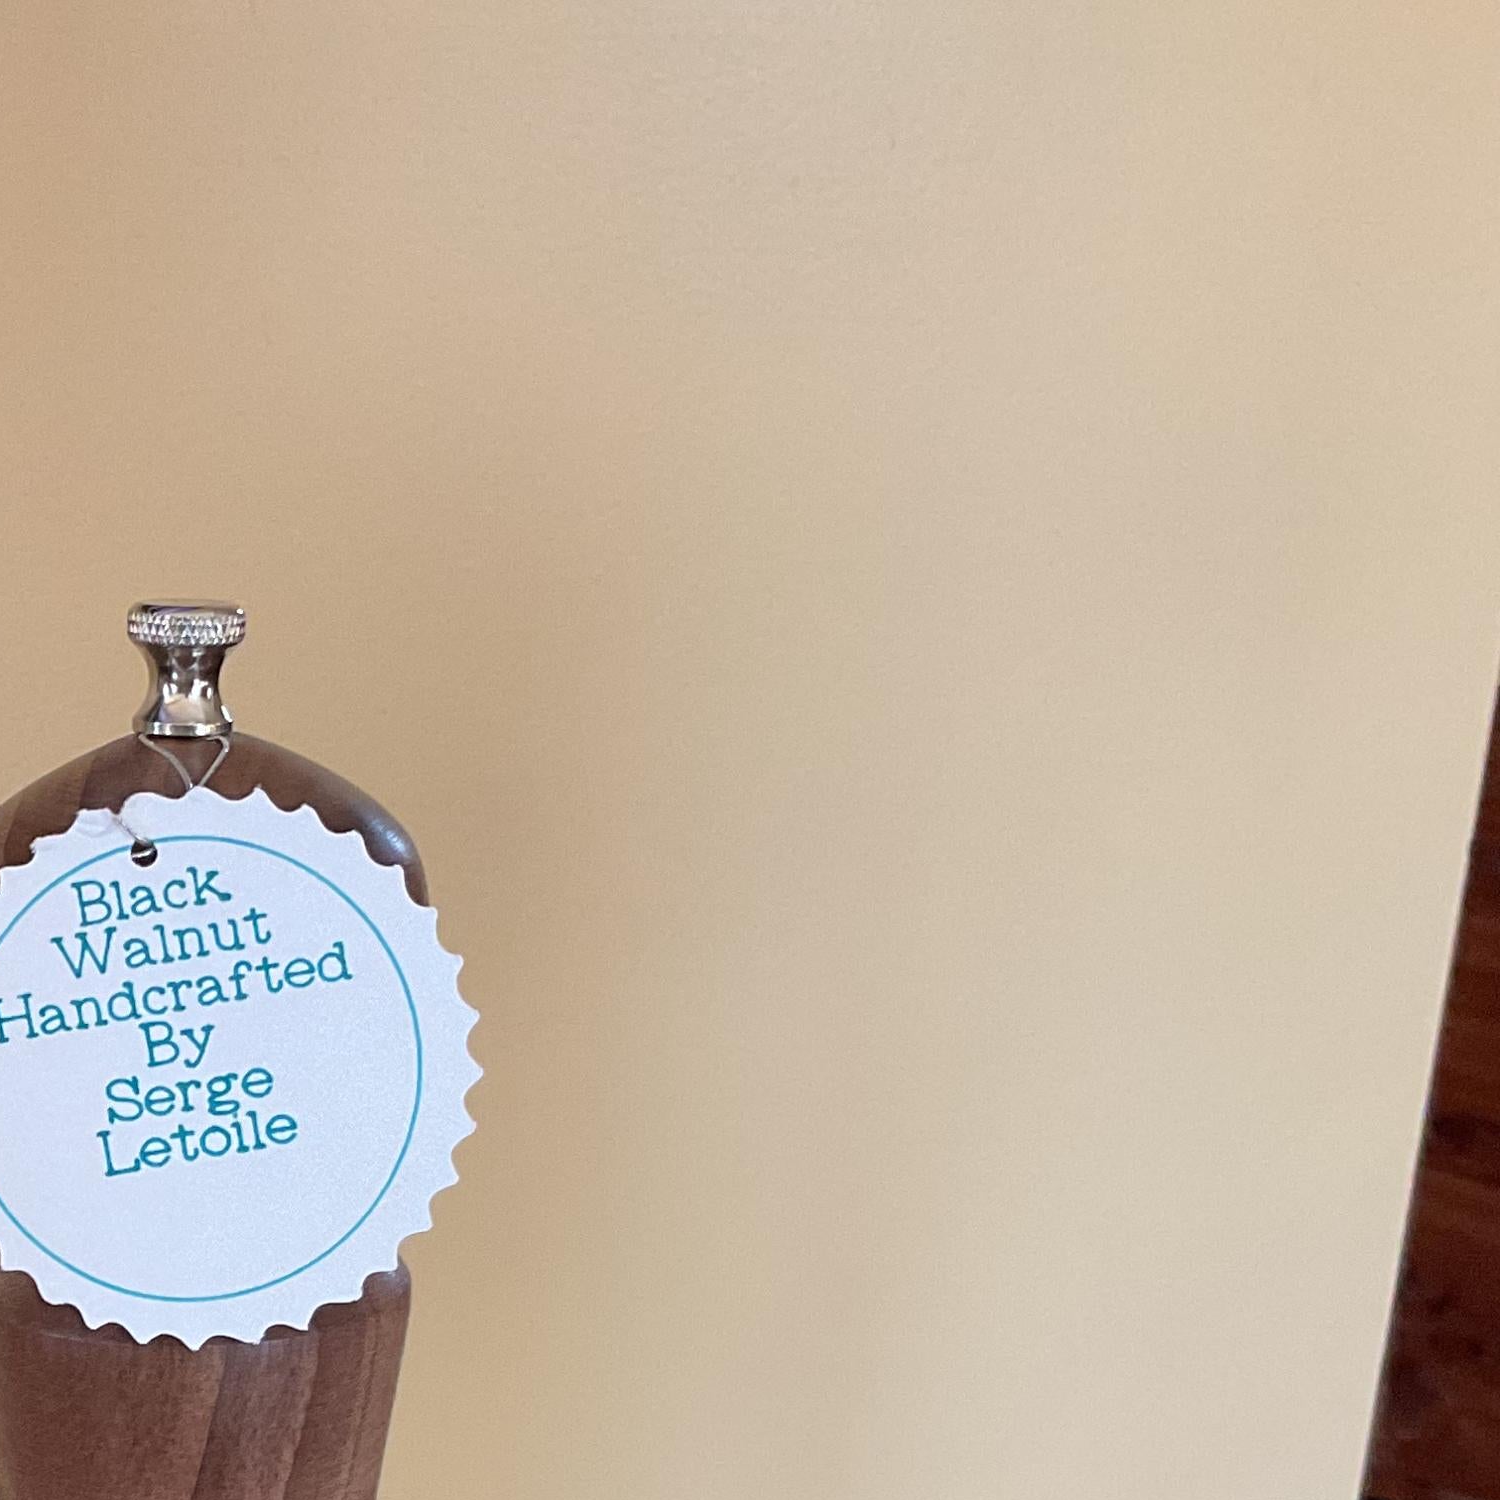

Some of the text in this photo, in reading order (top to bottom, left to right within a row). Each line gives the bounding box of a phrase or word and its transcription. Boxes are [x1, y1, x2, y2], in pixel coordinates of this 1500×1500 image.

[70, 865, 233, 928] Black
[50, 906, 273, 979] Walnut
[138, 1019, 215, 1069] By
[104, 1066, 275, 1125] Serge
[96, 1108, 300, 1178] Letoile
